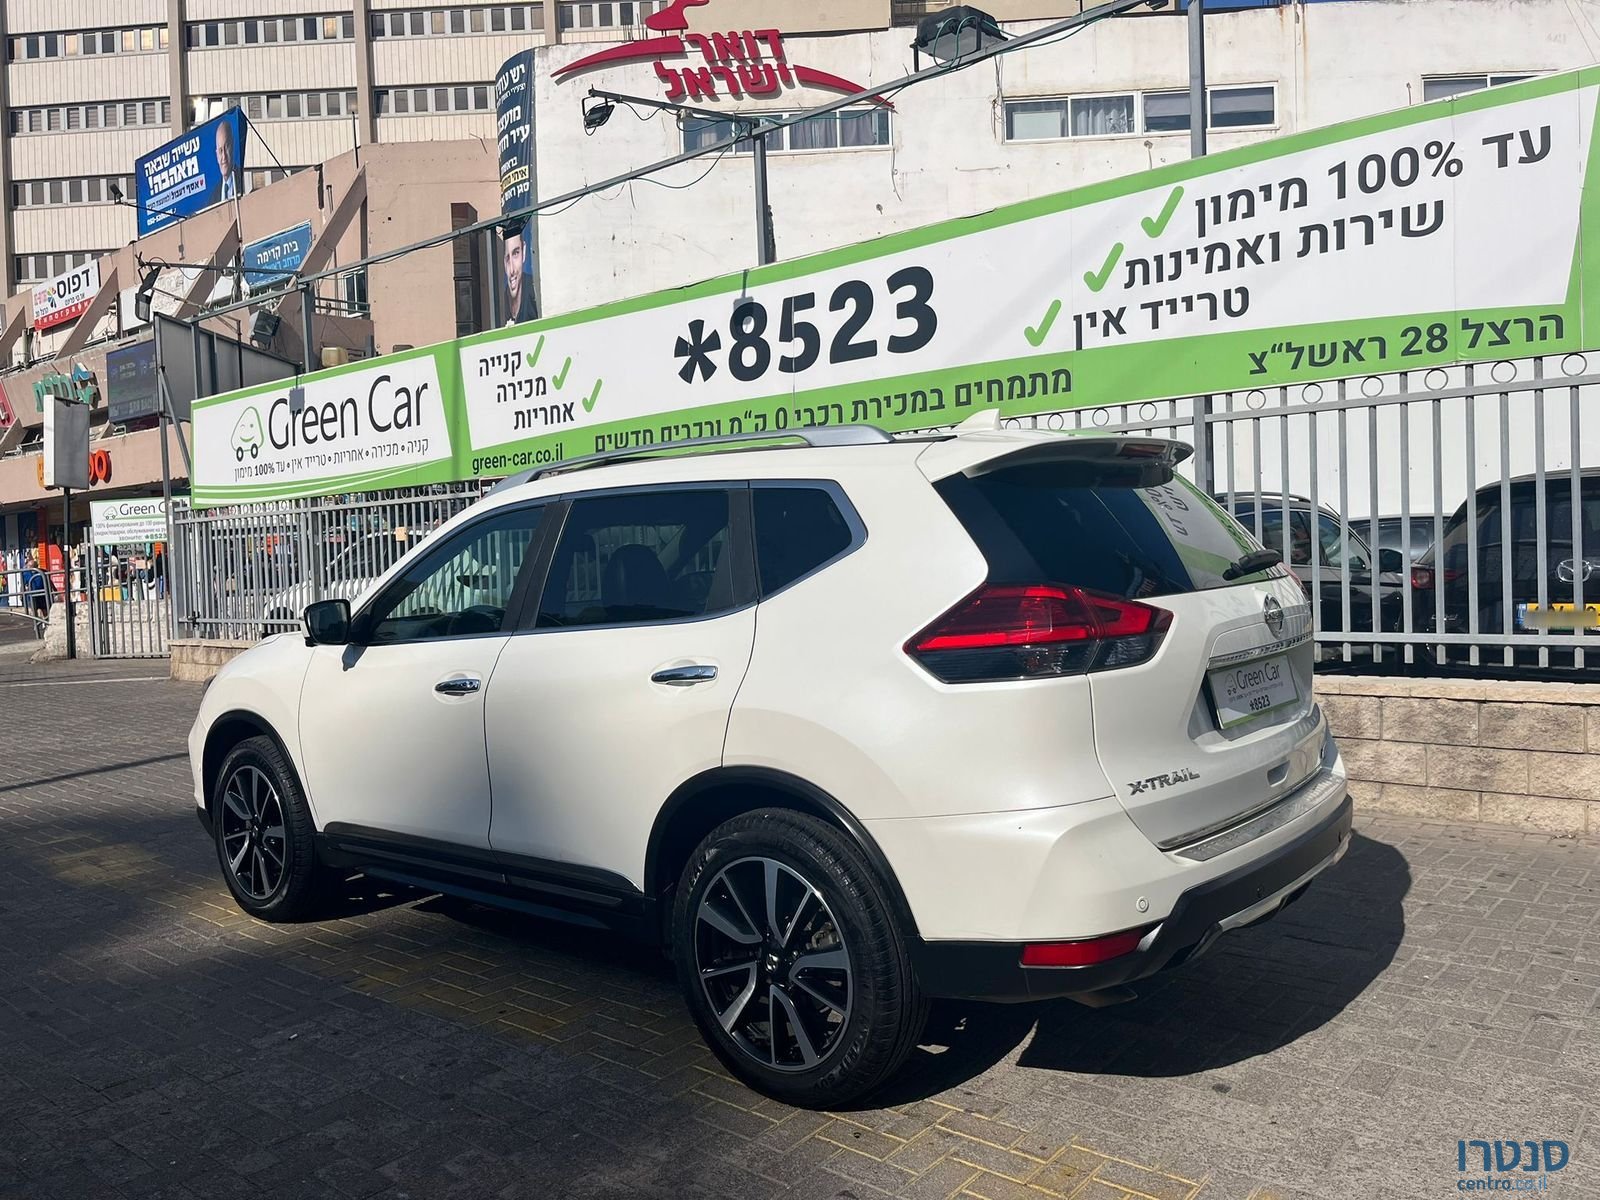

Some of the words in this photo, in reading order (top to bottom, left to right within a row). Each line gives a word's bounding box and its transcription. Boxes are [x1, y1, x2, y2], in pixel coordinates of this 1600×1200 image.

[685, 29, 782, 62] דואר
[510, 63, 526, 84] יש
[653, 62, 790, 98] ישראל
[498, 105, 522, 134] מועצ
[510, 123, 530, 144] עיר
[1482, 126, 1551, 168] עד
[171, 136, 200, 163] עשייה
[144, 151, 170, 177] שבאה
[148, 155, 200, 196] מאהבה!
[1328, 141, 1463, 199] 100%
[1195, 177, 1308, 238] מימון
[1297, 200, 1444, 258] שירות
[257, 245, 281, 265] קדימה
[283, 240, 299, 255] בית
[1124, 231, 1281, 289] ואמינות
[56, 268, 90, 299] דפוס
[1140, 286, 1250, 330] טרייד
[1073, 306, 1127, 350] אין
[1400, 323, 1448, 357] 28
[1461, 314, 1564, 348] הרצל
[479, 351, 521, 377] קנייה
[497, 376, 547, 403] מכירה
[955, 368, 1072, 407] מתמחים
[268, 398, 359, 450] Green
[368, 375, 429, 432] Car
[513, 402, 575, 430] אחריות
[775, 407, 788, 430] 0
[795, 403, 843, 428] רכבי
[851, 388, 945, 422] במכירת
[595, 429, 654, 453] חדשים
[660, 418, 721, 443] ורכבים
[305, 453, 326, 468] טרייד
[333, 447, 364, 465] אחריות
[371, 442, 399, 459] מכירה
[407, 438, 429, 456] קניה
[472, 443, 563, 474] green-car.co.il
[234, 465, 253, 483] מימון
[254, 461, 275, 476] 100%
[276, 460, 286, 472] עד
[291, 458, 303, 475] אין
[120, 503, 156, 516] Green
[1236, 669, 1265, 690] Green
[1264, 662, 1280, 681] Car
[1126, 767, 1201, 796] X-TRAIL
